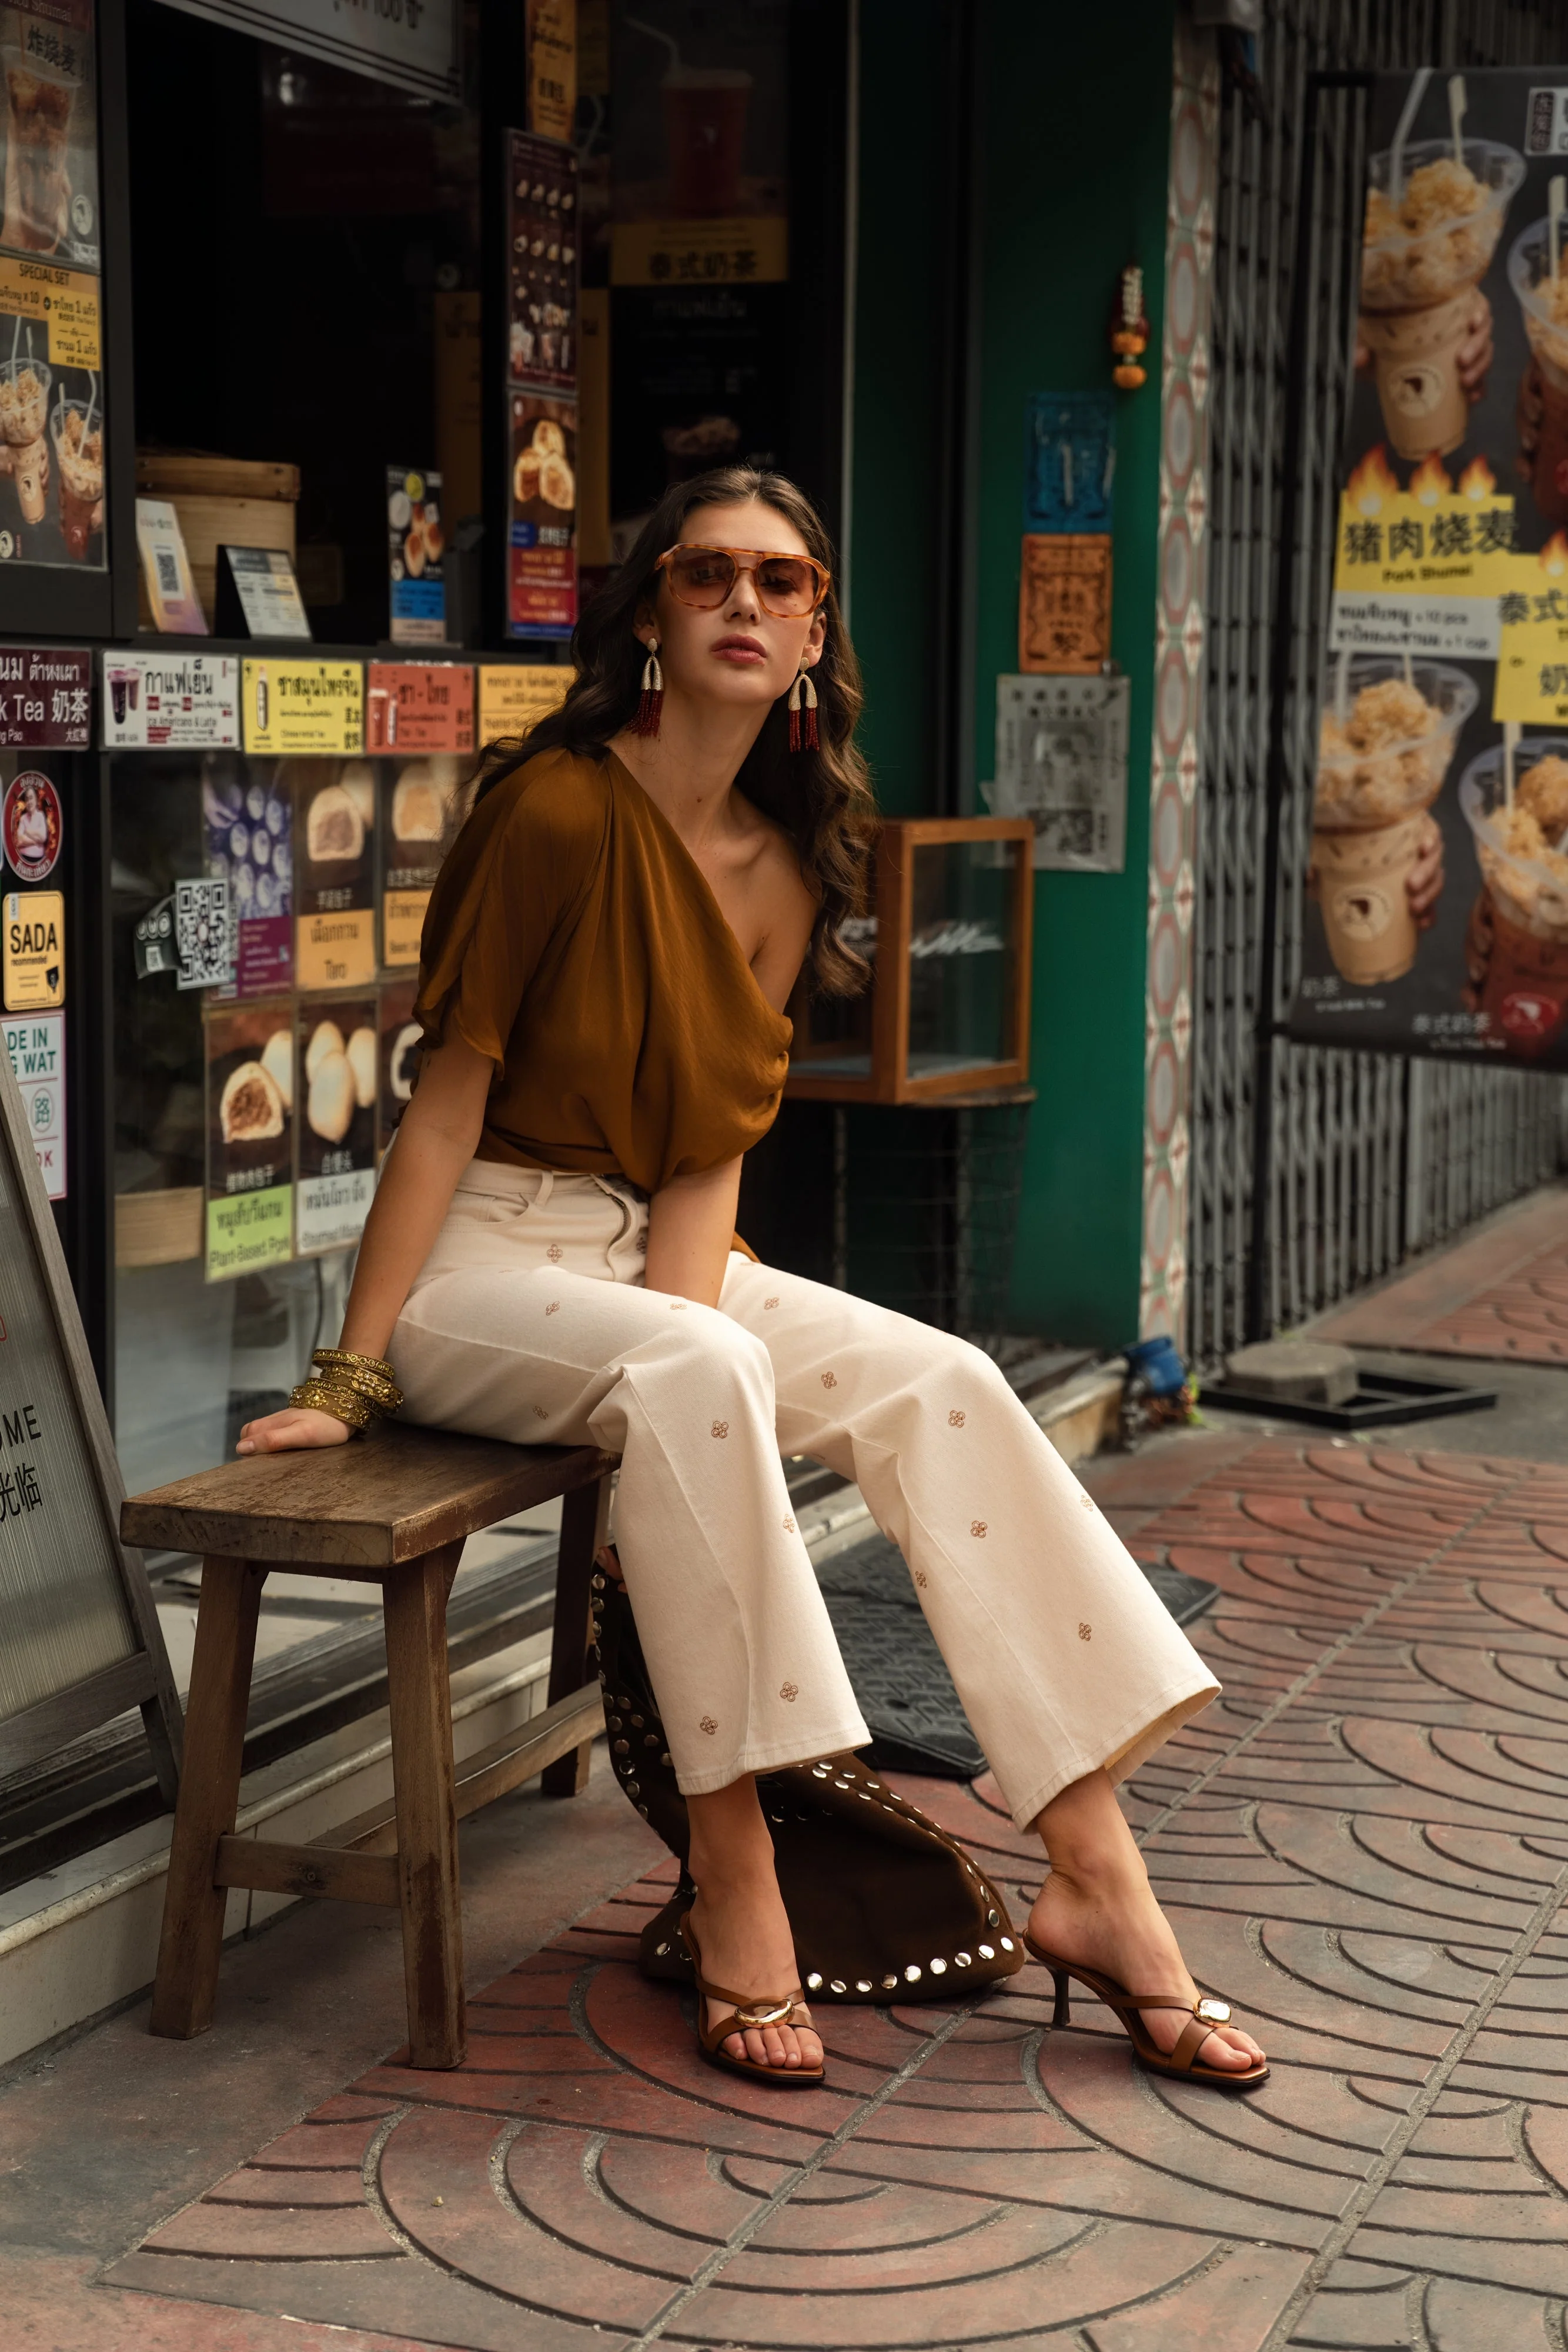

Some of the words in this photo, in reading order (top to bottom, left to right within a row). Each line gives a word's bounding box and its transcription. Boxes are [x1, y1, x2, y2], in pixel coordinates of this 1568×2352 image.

[19, 263, 53, 283] SPECIAL
[55, 270, 69, 285] SET
[76, 300, 81, 313] 1
[76, 339, 82, 353] 1
[1344, 505, 1519, 565] 猪肉烧麦
[0, 656, 24, 681] นม
[29, 653, 80, 682] ต้าหงเผา
[145, 658, 213, 694] กาแฟเย็น
[12, 693, 45, 722] Tea
[51, 687, 89, 724] 奶茶
[8, 728, 24, 741] Pao
[11, 923, 58, 954] SADA
[11, 956, 47, 967] recommended
[324, 958, 347, 980] Taro
[33, 1027, 48, 1048] IN
[24, 1051, 56, 1074] WAT
[0, 1405, 41, 1451] ME
